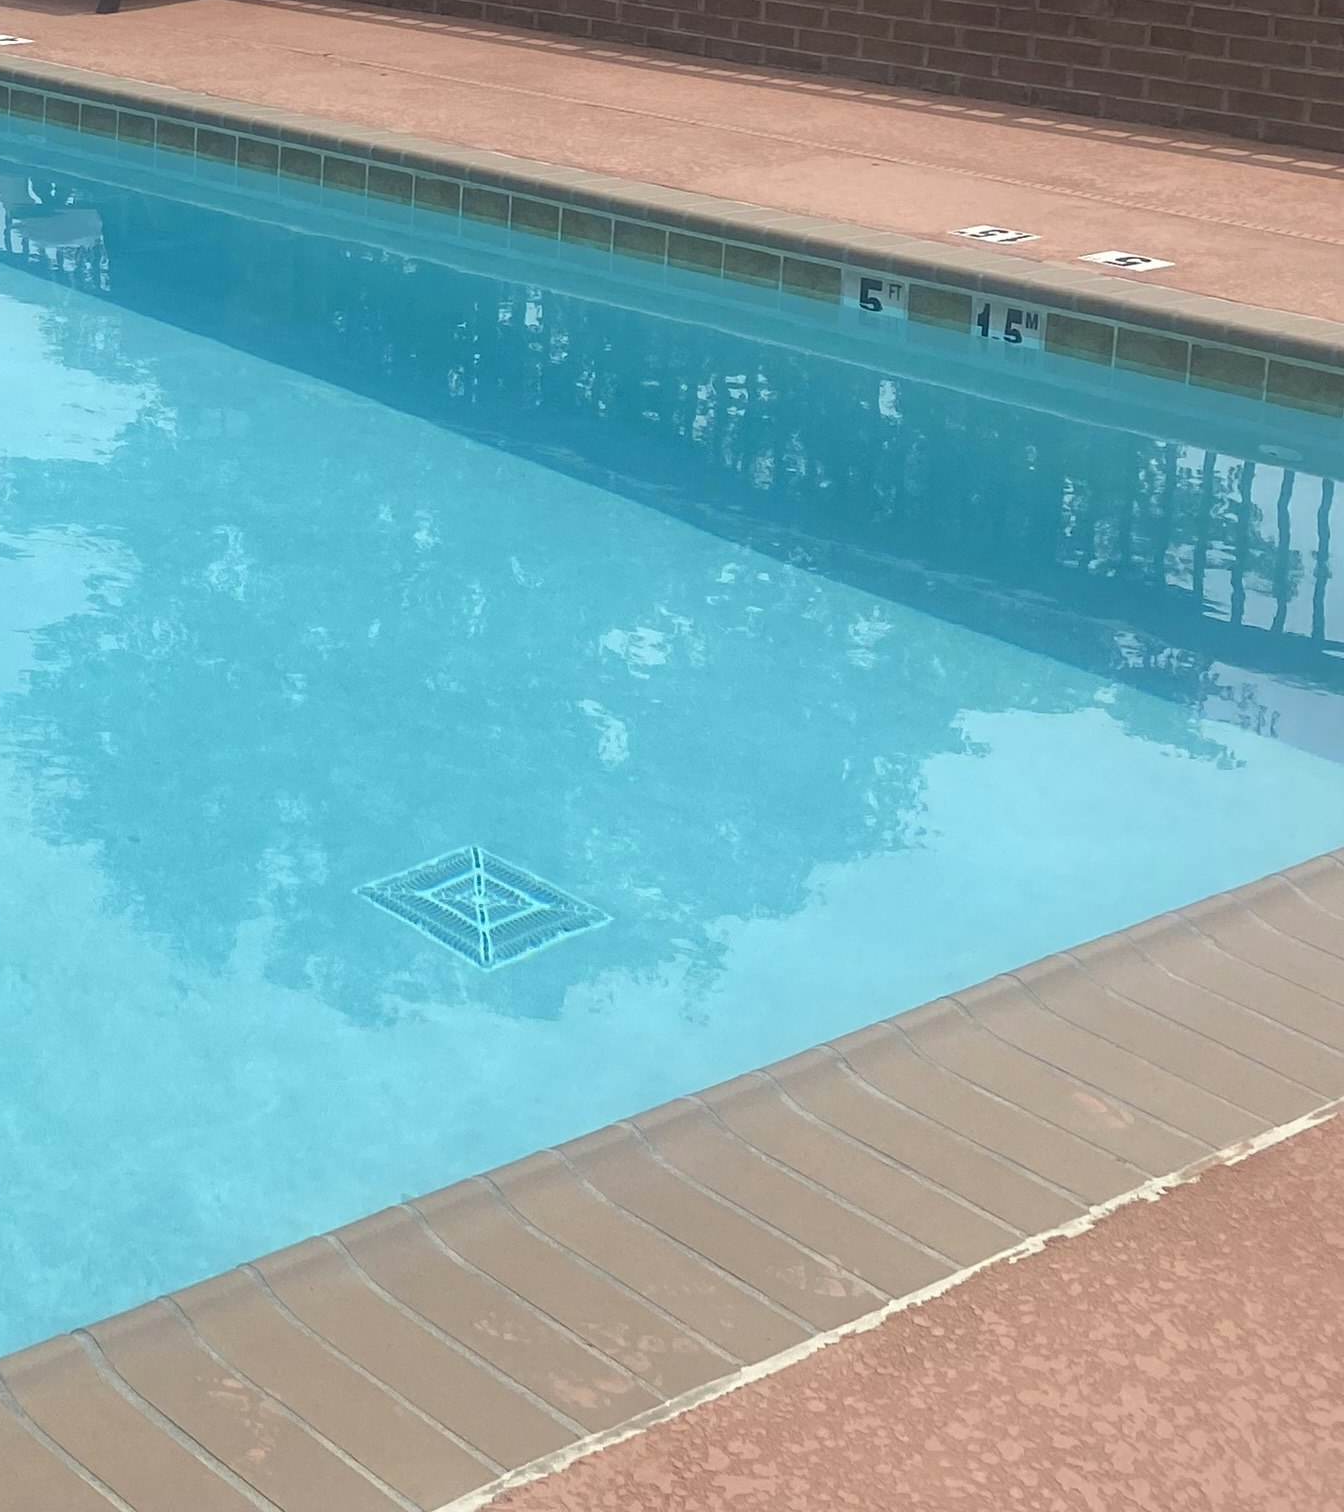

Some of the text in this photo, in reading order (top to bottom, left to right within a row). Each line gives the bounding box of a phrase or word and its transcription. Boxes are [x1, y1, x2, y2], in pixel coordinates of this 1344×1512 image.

[859, 277, 883, 312] 5
[888, 283, 902, 301] FT
[1026, 311, 1039, 330] M
